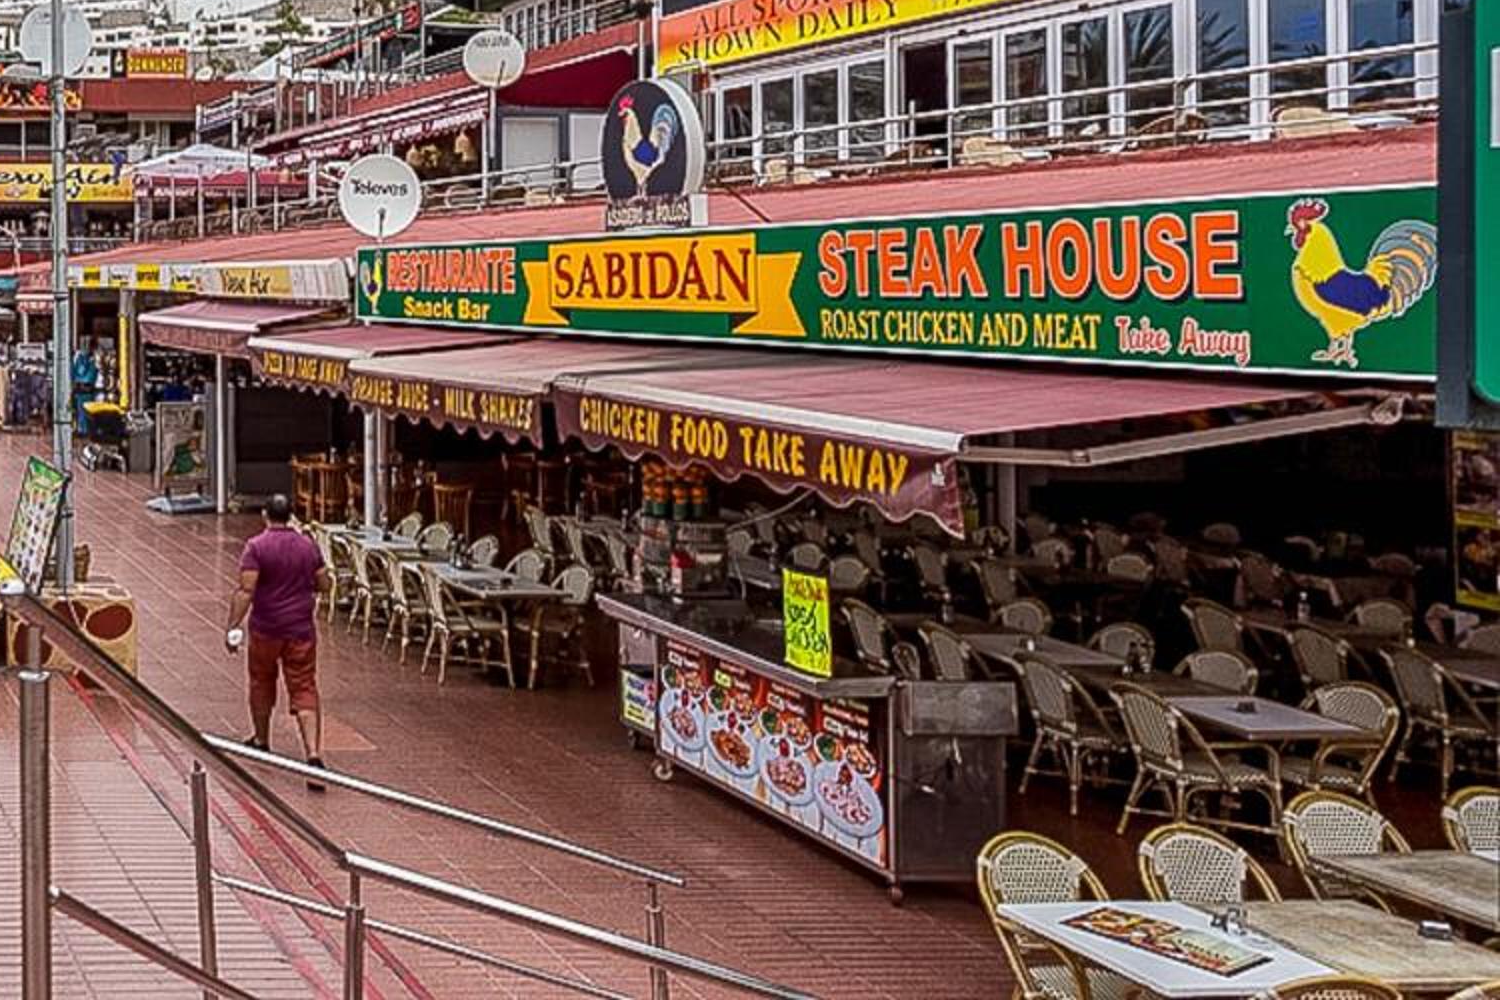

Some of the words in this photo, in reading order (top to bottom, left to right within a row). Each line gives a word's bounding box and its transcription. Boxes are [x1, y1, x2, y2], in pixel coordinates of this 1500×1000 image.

[677, 20, 783, 63] SHOWN
[691, 7, 746, 37] ALL
[387, 247, 517, 295] RESTAURANTE
[555, 241, 752, 301] SABIDÁN
[818, 223, 989, 297] STEAK
[1003, 212, 1244, 300] HOUSE
[403, 296, 453, 319] Snack
[458, 298, 492, 320] Bar
[821, 309, 879, 341] ROAST
[883, 311, 975, 344] CHICKEN
[979, 314, 1028, 346] AND
[1033, 314, 1101, 350] MEAT
[1114, 315, 1172, 354] Take
[1176, 318, 1251, 368] Away
[352, 375, 394, 406] ORANGE
[397, 380, 430, 411] JUICE
[444, 387, 477, 420] MILK
[479, 393, 533, 430] SHAKES
[579, 397, 660, 447] CHICKEN
[670, 413, 729, 461] FOOD
[739, 426, 807, 477] TAKE
[819, 439, 908, 496] AWAY
